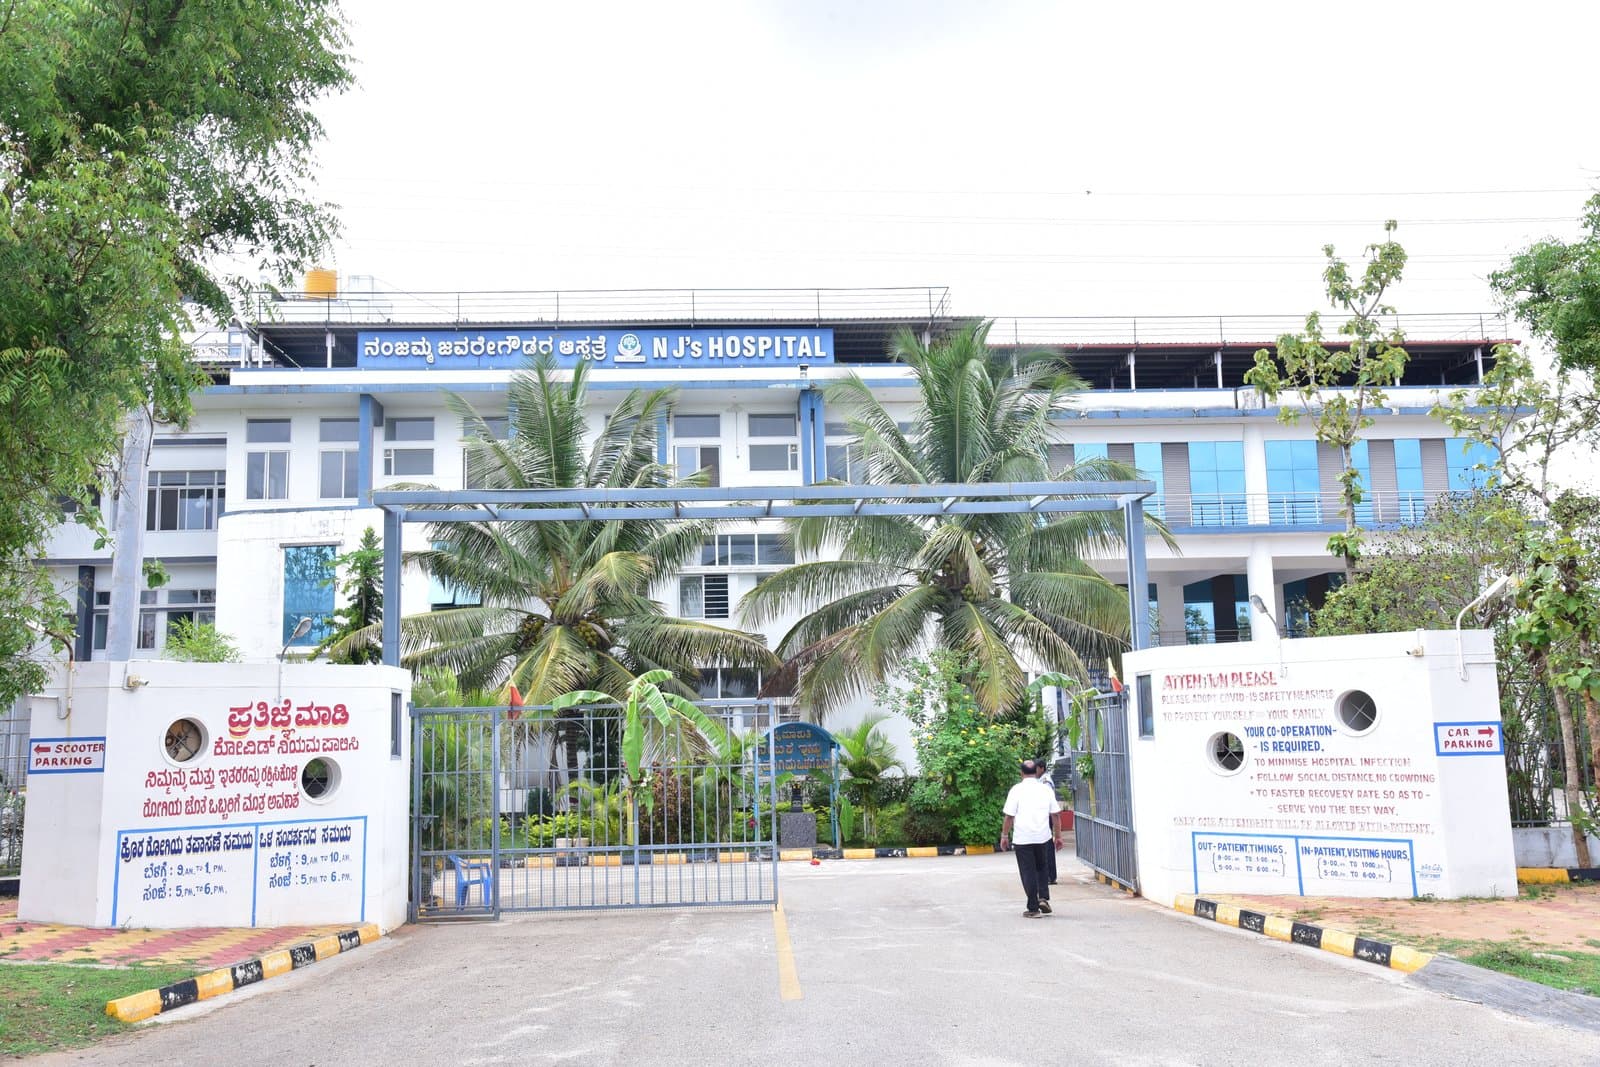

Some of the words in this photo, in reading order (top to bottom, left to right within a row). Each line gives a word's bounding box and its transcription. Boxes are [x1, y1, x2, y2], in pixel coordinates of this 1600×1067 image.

[364, 336, 434, 364] ನಂಜಮ್ಮ
[438, 335, 553, 357] ಜವರೇಗೌಡರ
[559, 335, 608, 361] ಆಸ್ಪತ್ರೆ
[653, 337, 667, 358] N
[672, 336, 703, 358] J's
[708, 335, 827, 358] HOSPITAL
[228, 699, 296, 740] ಪ್ರತಿಜ್ಞೆ
[295, 701, 350, 727] ಮಾಡಿ
[1243, 726, 1265, 738] YOUR
[1448, 728, 1470, 737] CAR
[54, 743, 105, 754] SCOOTER
[213, 735, 275, 756] ಕೋವಿಡ್
[277, 736, 320, 754] ನಿಯಮ
[322, 736, 359, 752] ಪಾಲಿಸಿ
[1272, 741, 1325, 752] REQUIRED.
[1444, 740, 1493, 749] PARKING
[35, 756, 93, 767] PARKING
[1254, 758, 1266, 767] TO
[1268, 757, 1308, 767] MINIMISE
[1312, 758, 1357, 767] HOSPITAL
[1360, 758, 1411, 768] INFECTION
[145, 768, 188, 794] ನಿಮ್ಮನ್ನು
[189, 766, 216, 790] ಮತ್ತು
[218, 765, 260, 788] ಇತರರನ್ನು
[1256, 773, 1294, 783] FOLLOW
[1297, 773, 1331, 783] SOCIAL
[1389, 773, 1435, 784] CROWDING
[1256, 789, 1268, 798] TO
[1271, 789, 1305, 798] FASTER
[1308, 789, 1354, 799] RECOVERY
[1357, 790, 1380, 799] RATE
[1383, 790, 1395, 799] SO
[1398, 791, 1409, 800] AS
[1411, 791, 1424, 800] TO
[143, 797, 182, 818] ರೋಗಿಯ
[184, 795, 207, 816] ಜೊತೆ
[1277, 804, 1306, 814] SERVE
[1308, 805, 1327, 814] YOU
[1329, 805, 1347, 815] THE
[1349, 805, 1371, 815] BEST
[259, 829, 273, 848] ಒಳ
[321, 824, 352, 844] ಸಮಯ
[145, 835, 183, 857] ರೋಗಿಯ
[185, 831, 221, 854] ತಪಾಸಣೆ
[222, 830, 253, 851] ಸಮಯ
[269, 872, 292, 889] ಸಂಜೆ
